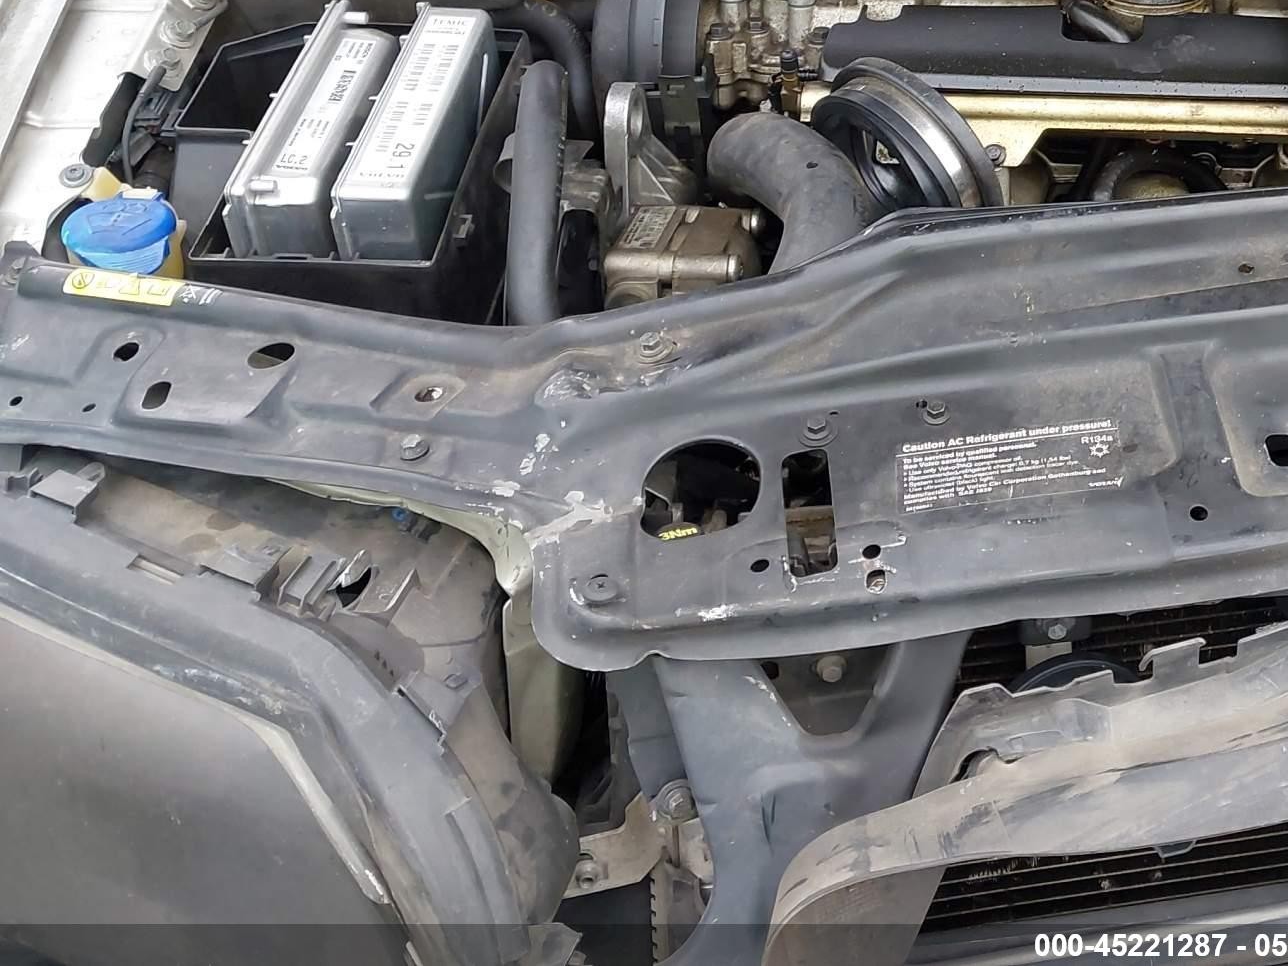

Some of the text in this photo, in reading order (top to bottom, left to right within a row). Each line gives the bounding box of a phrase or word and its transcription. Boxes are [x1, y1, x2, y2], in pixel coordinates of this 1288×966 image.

[902, 439, 945, 452] Caution
[947, 437, 963, 446] AC
[966, 429, 1026, 445] Refrigerant
[1028, 425, 1059, 437] under
[1081, 433, 1113, 445] R134a
[658, 527, 698, 541] 3Nm
